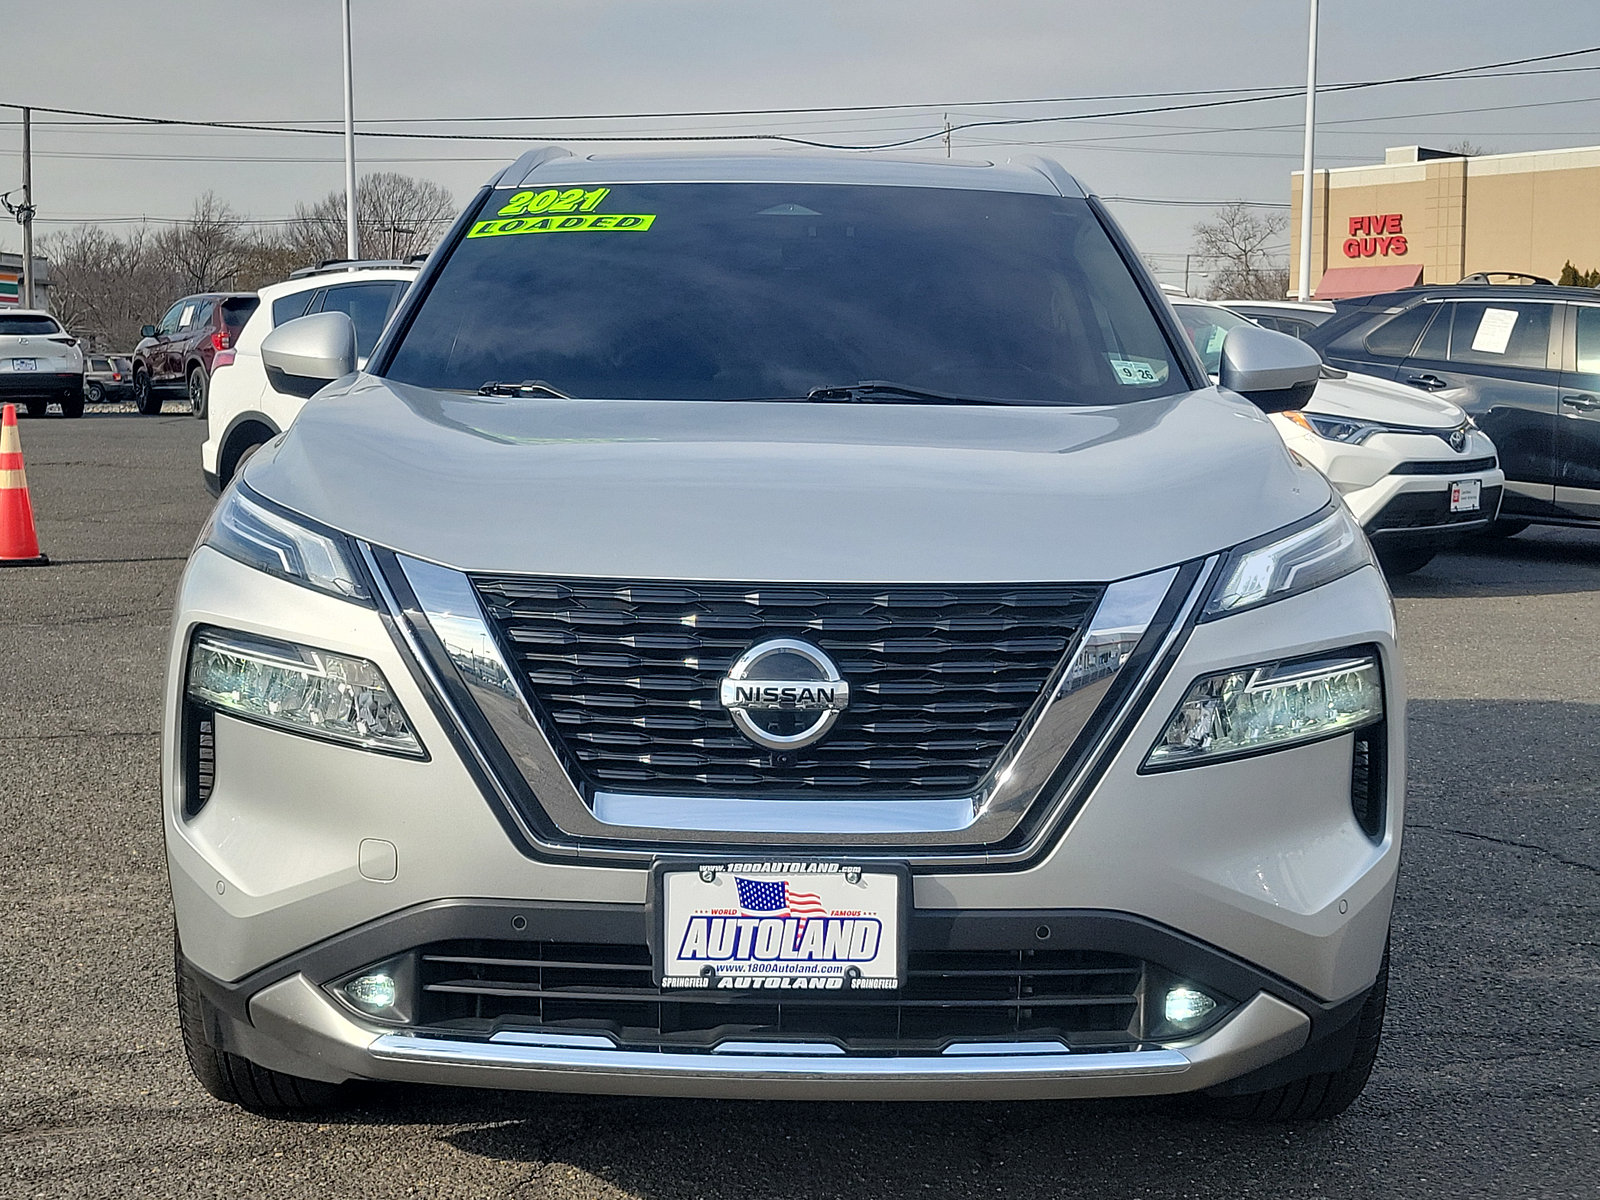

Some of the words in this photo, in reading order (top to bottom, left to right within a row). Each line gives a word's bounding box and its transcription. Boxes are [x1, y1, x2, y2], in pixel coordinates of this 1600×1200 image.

[498, 188, 610, 216] 2021
[475, 216, 643, 235] LOADED
[1349, 214, 1403, 236] FIVE
[1343, 236, 1408, 258] GUYS
[1122, 367, 1132, 378] 9
[1138, 369, 1154, 380] 26
[735, 686, 835, 703] NISSAN
[699, 862, 861, 874] www.1800AUTOLAND.com
[677, 916, 882, 962] AUTOLAND
[715, 963, 843, 975] www.1800Autoland.com
[661, 977, 709, 988] SPRINGFIELD
[717, 977, 843, 990] AUTOLAND
[850, 978, 898, 990] SPRINGFIELD
